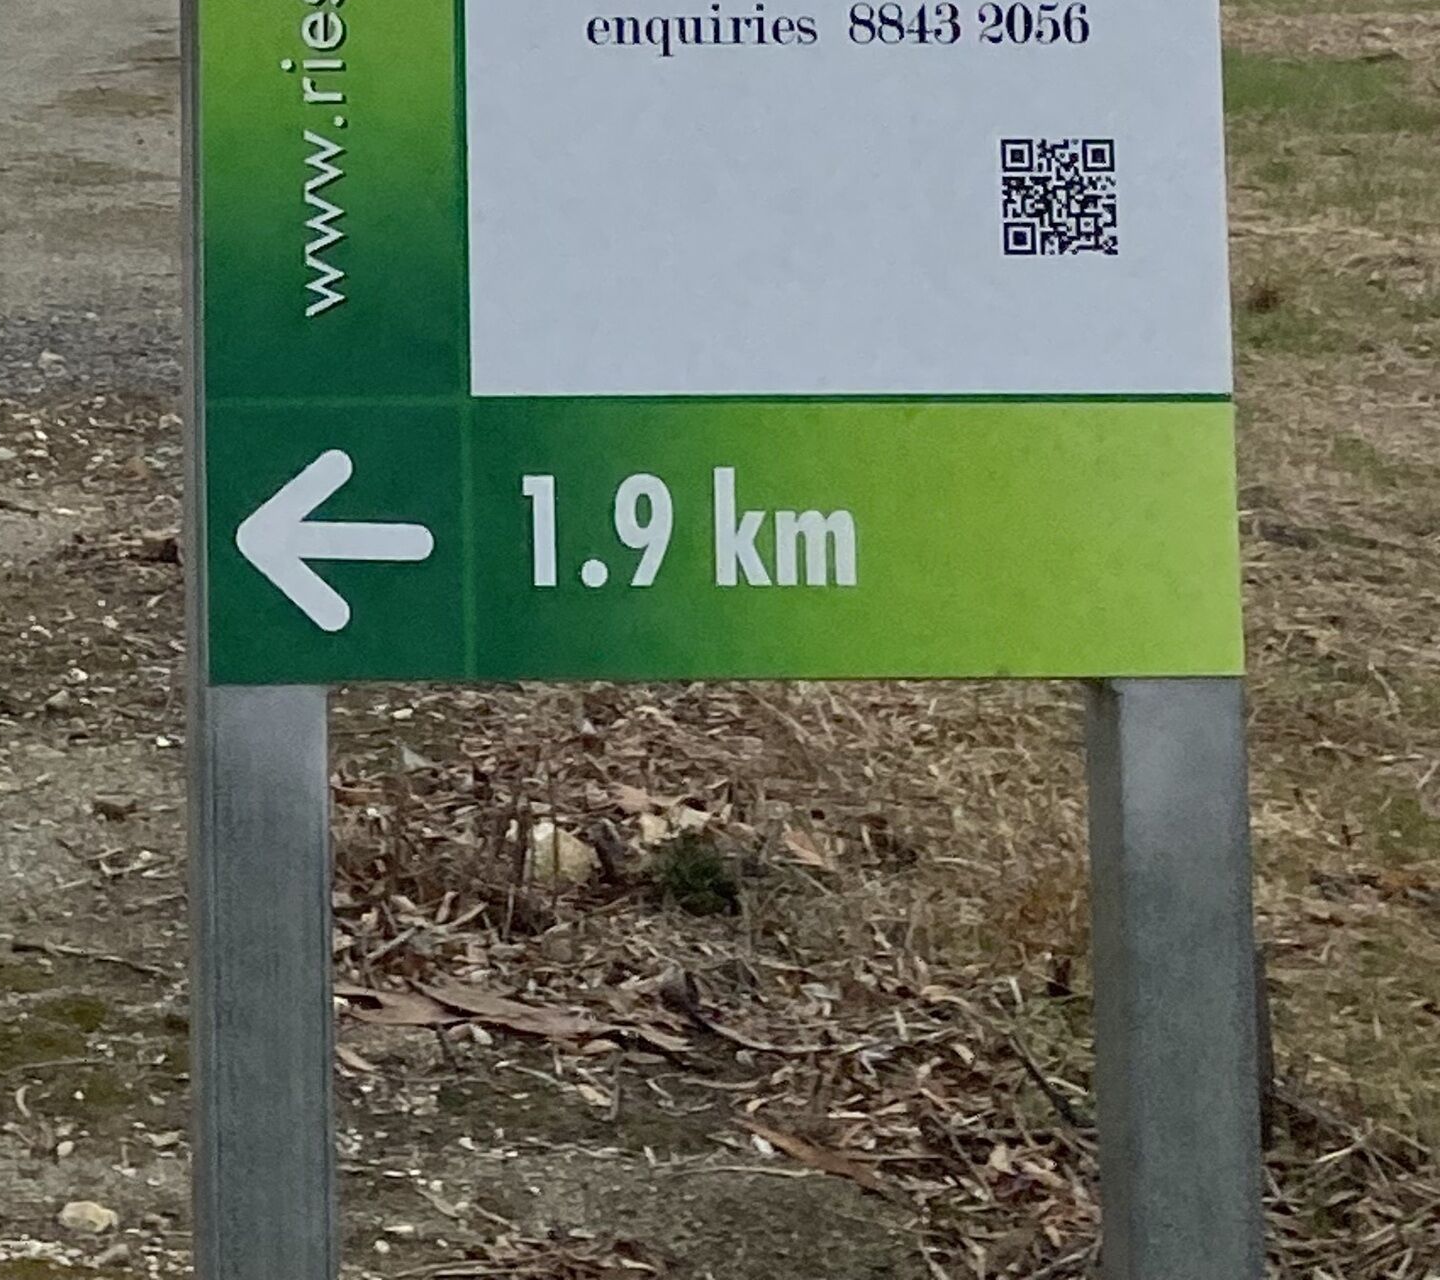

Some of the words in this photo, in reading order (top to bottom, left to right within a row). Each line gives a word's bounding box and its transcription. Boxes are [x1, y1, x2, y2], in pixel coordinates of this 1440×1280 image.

[586, 3, 818, 58] enquiries
[848, 2, 961, 45] 8843
[977, 1, 1091, 46] 2056
[522, 473, 673, 588] 1.9
[714, 467, 857, 586] km
